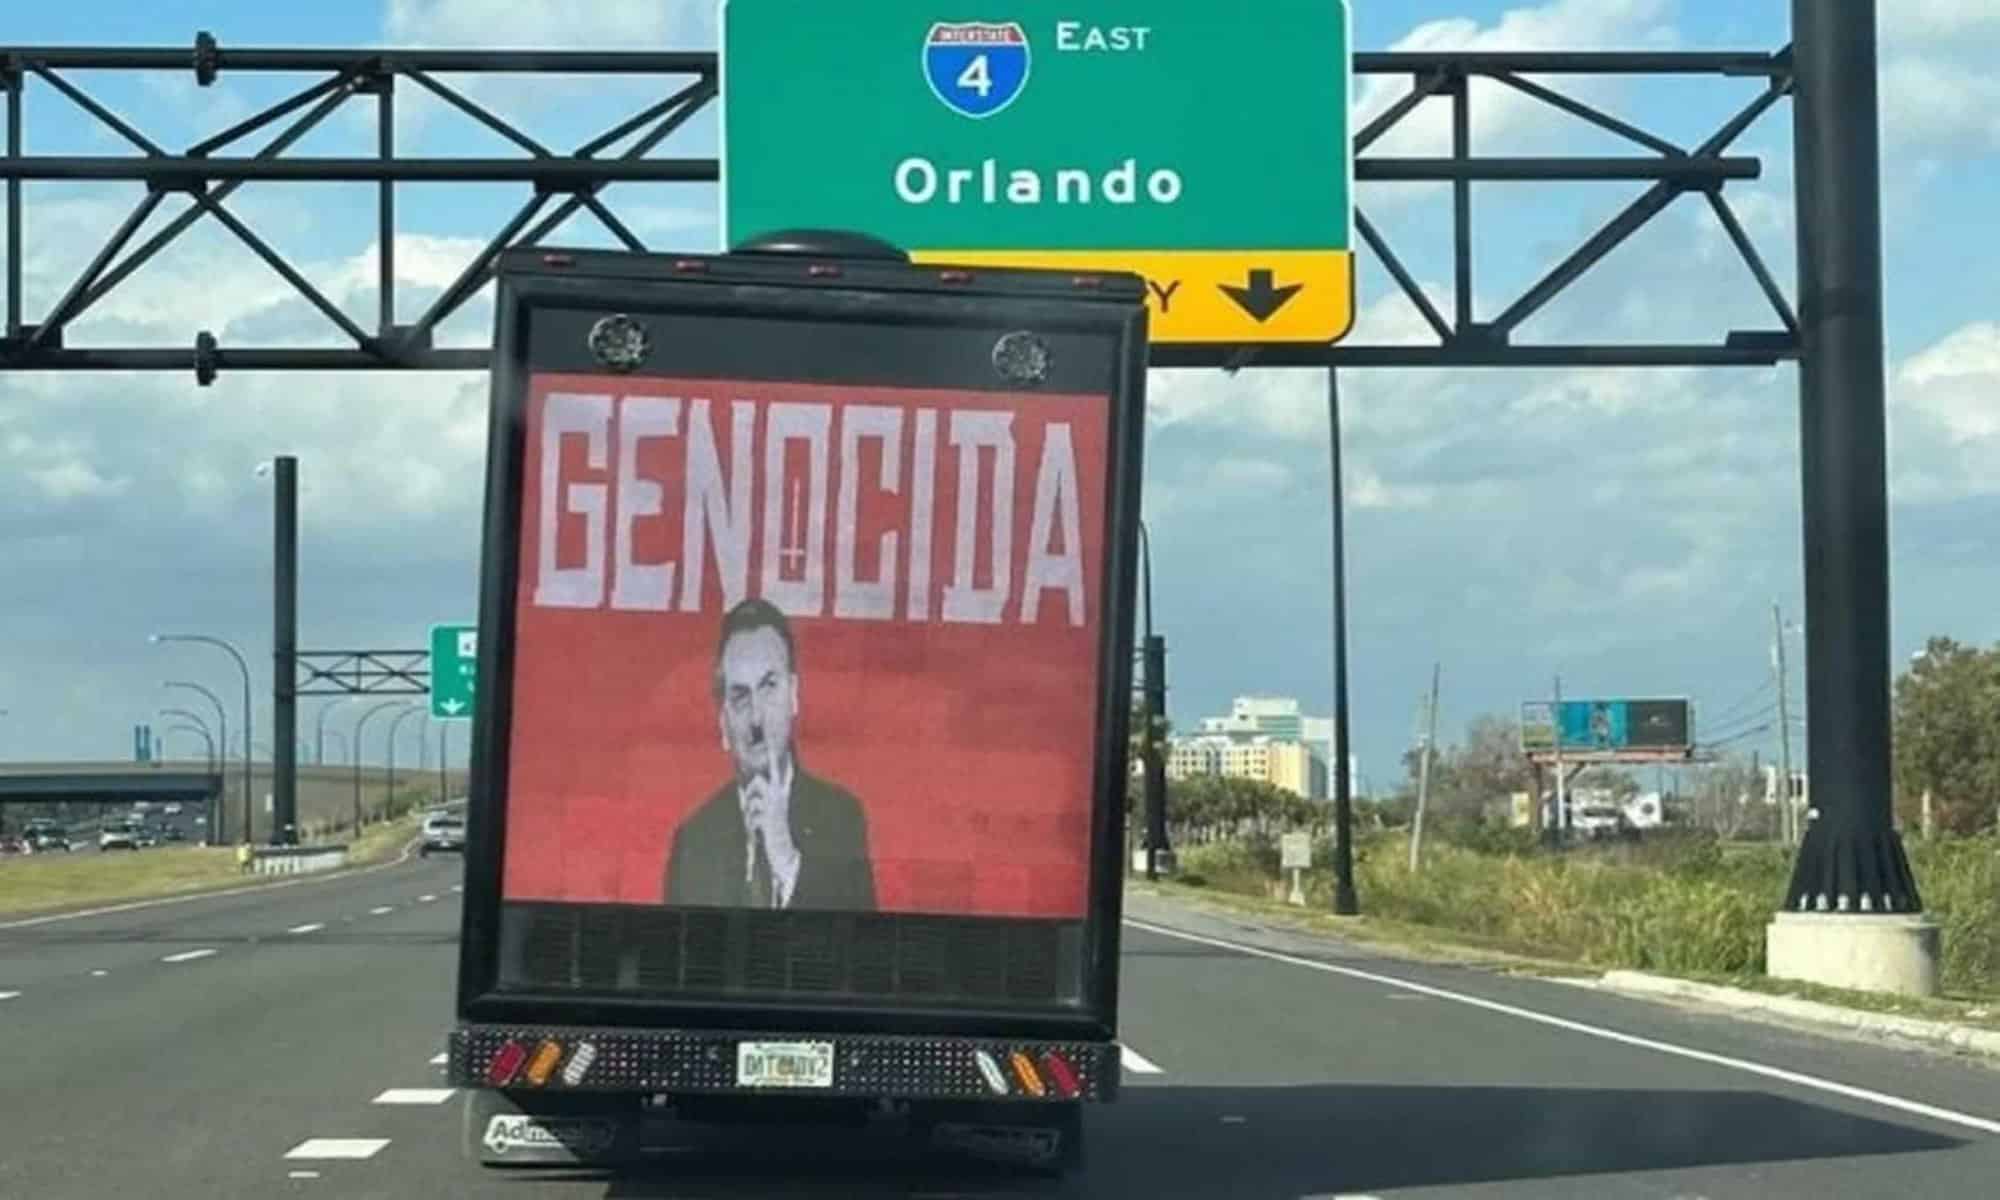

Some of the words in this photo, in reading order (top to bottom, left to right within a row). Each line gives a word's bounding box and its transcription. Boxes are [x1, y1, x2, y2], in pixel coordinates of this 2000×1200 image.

[1056, 21, 1151, 51] EAST
[956, 54, 993, 97] 4
[895, 156, 1183, 204] Orlando
[533, 392, 1086, 627] GENOCIDA
